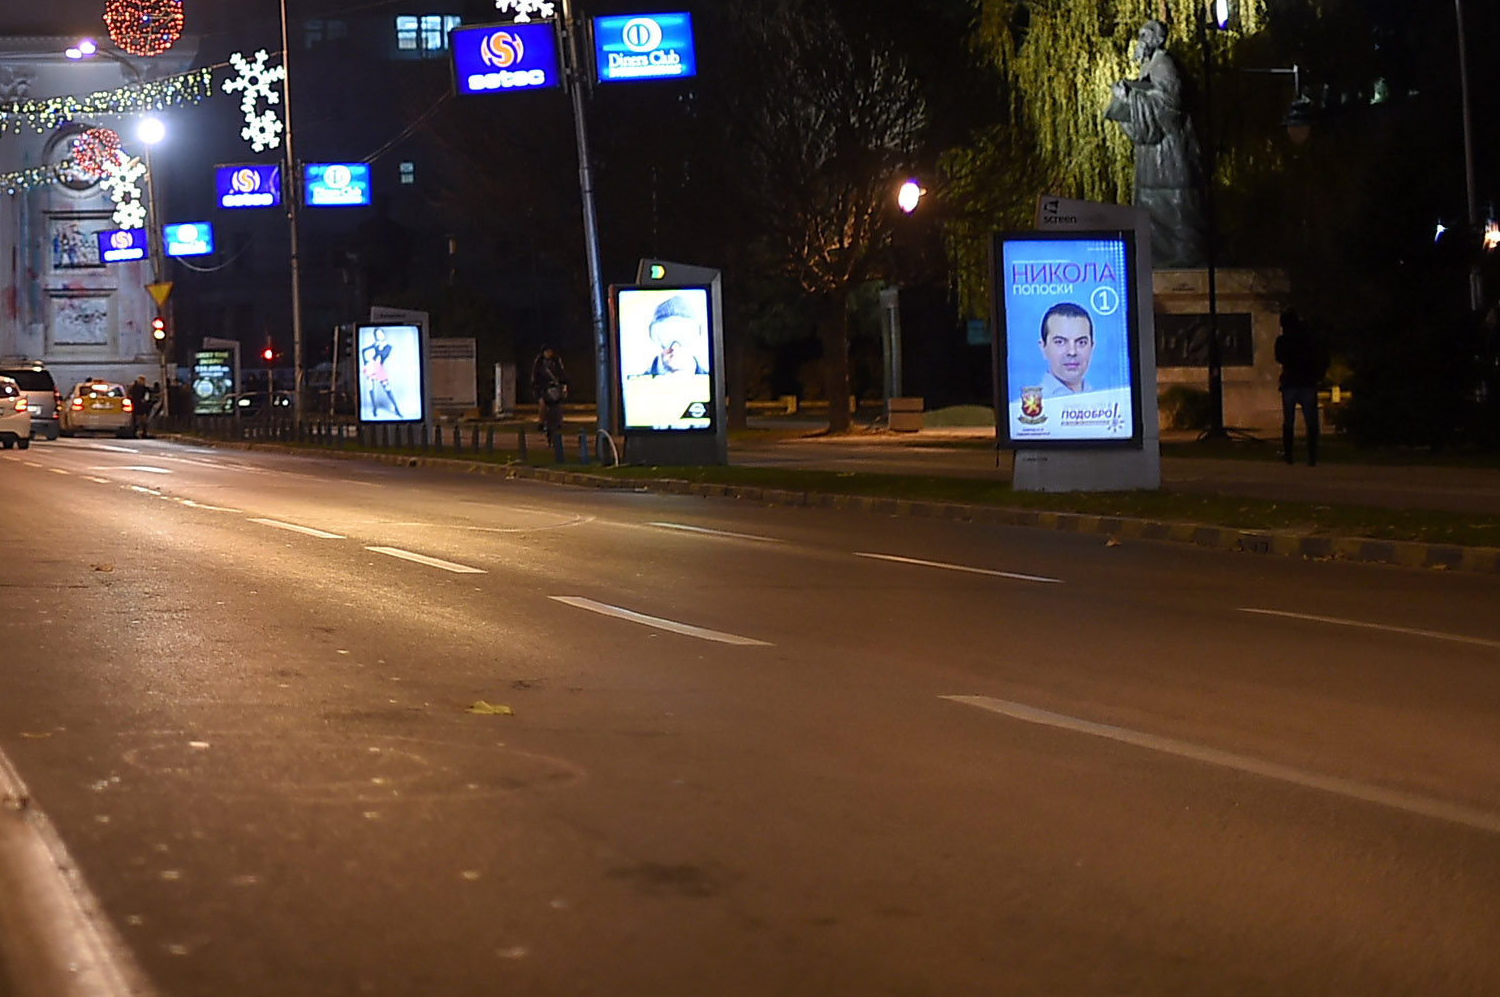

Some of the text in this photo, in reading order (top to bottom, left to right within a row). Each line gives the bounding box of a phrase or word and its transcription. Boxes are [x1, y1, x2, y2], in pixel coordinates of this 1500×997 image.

[608, 49, 680, 68] Diners Club
[1012, 263, 1117, 284] НИКОЛА
